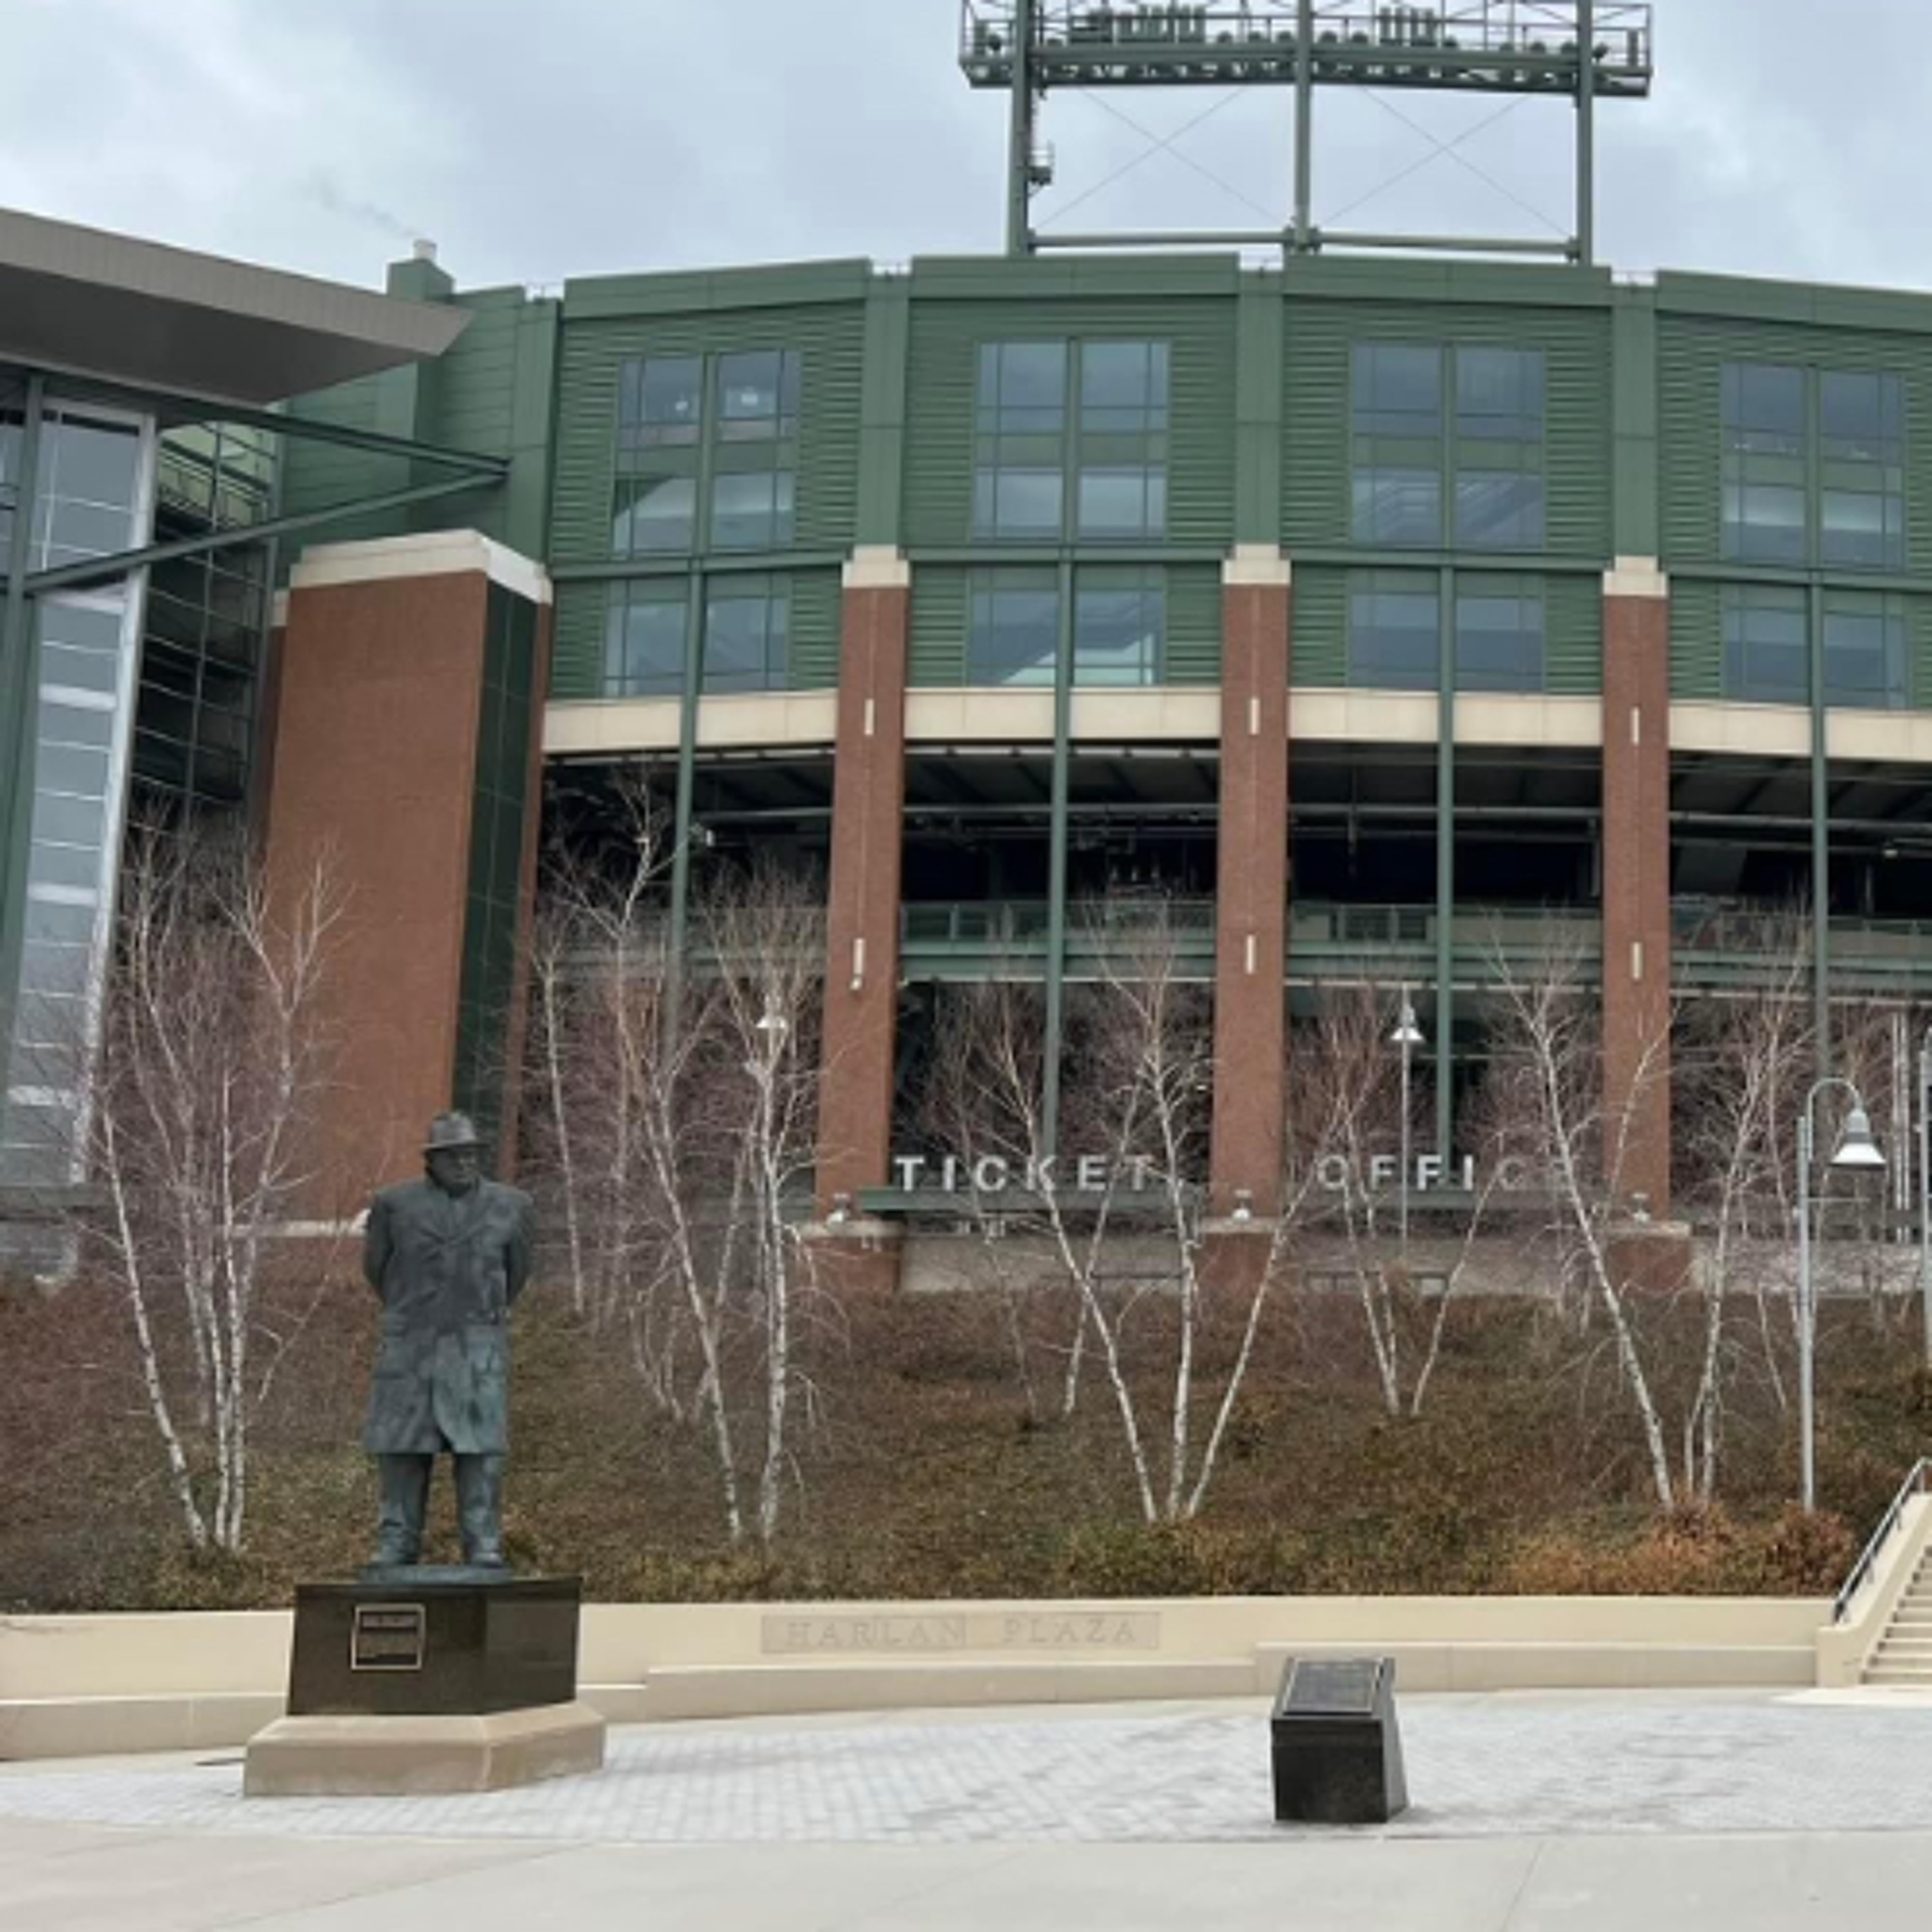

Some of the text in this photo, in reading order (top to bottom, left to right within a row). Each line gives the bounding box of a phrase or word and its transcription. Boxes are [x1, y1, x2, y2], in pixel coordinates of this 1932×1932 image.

[894, 1155, 1156, 1191] TICKET
[786, 1618, 1137, 1647] HARLAN PLAZA
